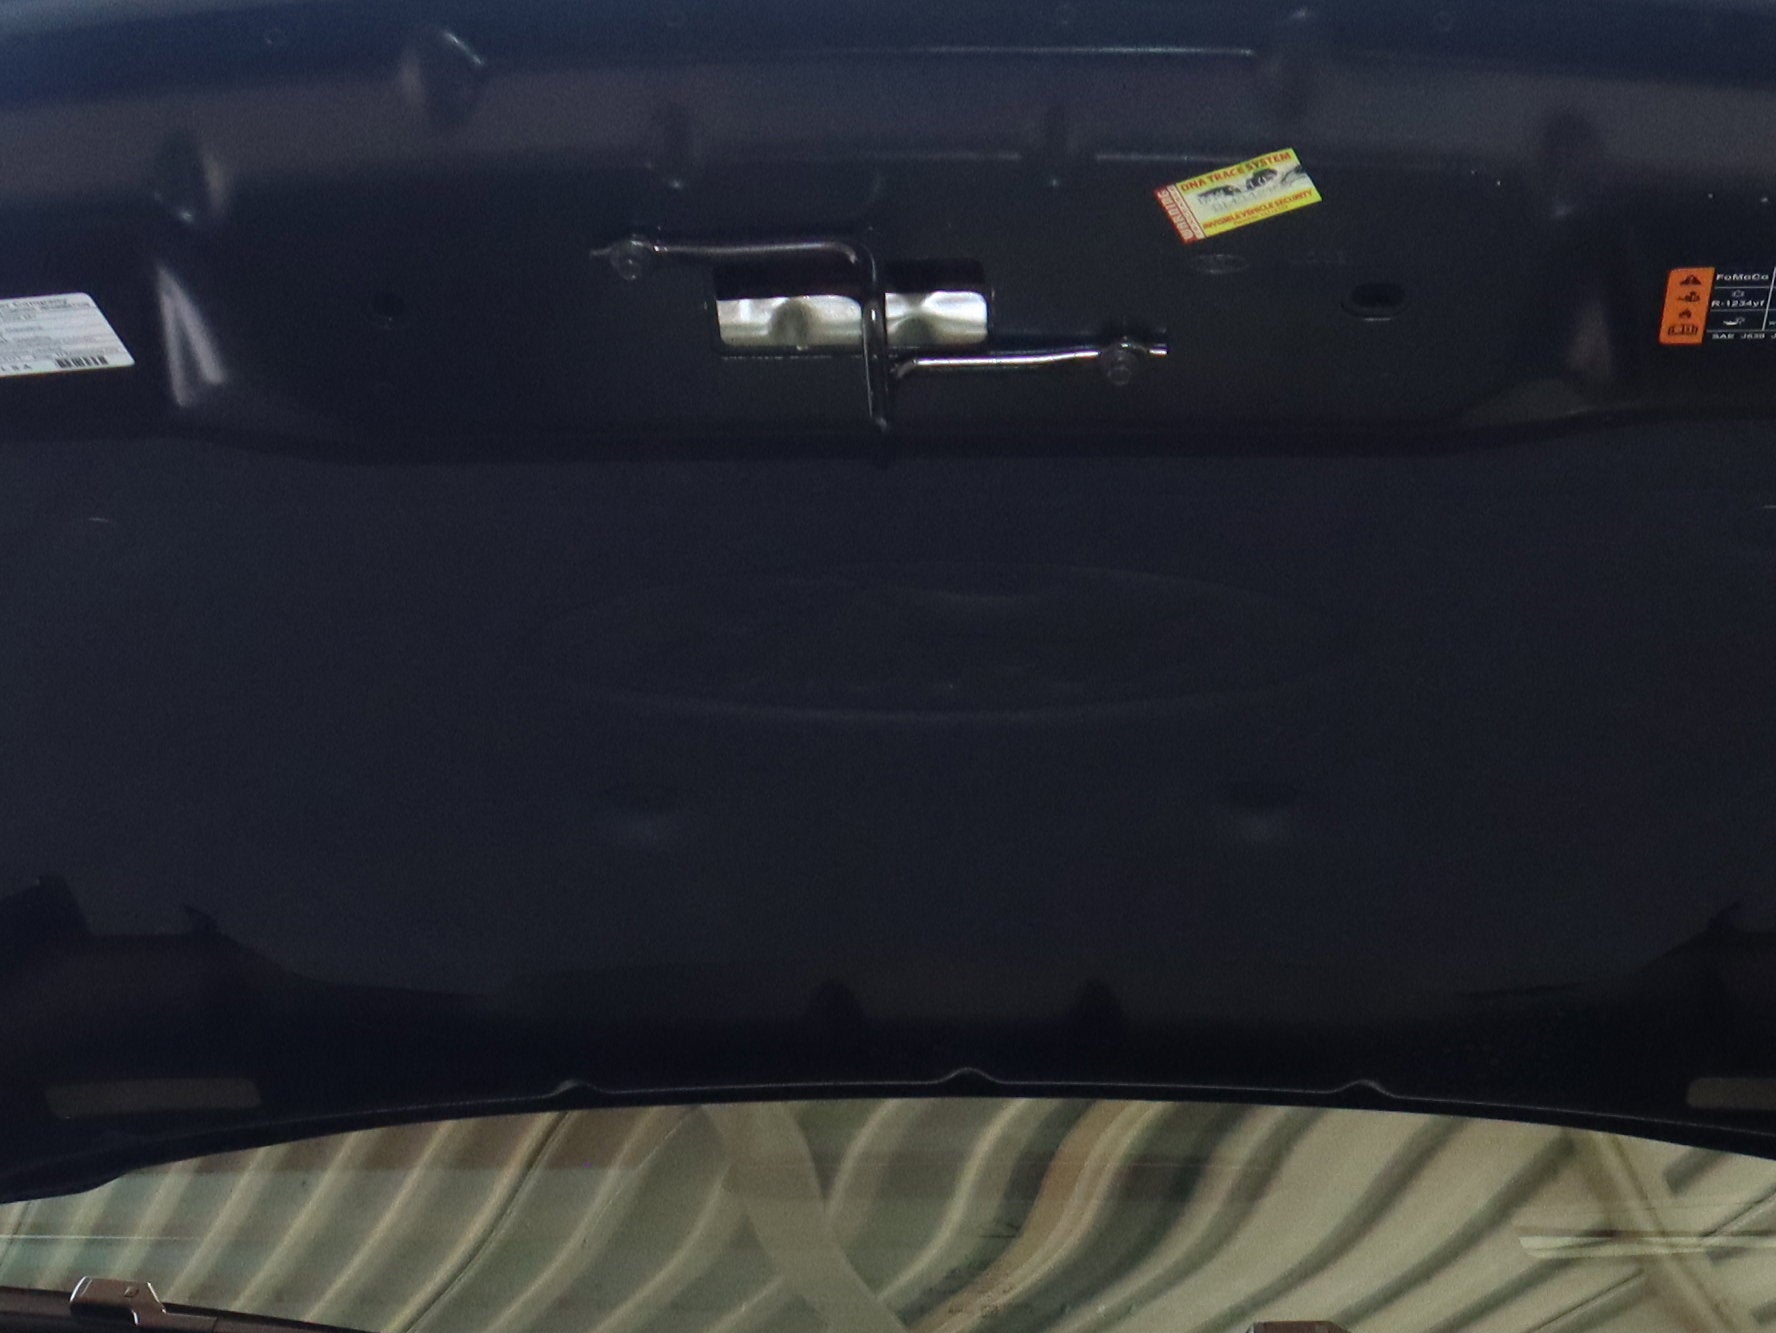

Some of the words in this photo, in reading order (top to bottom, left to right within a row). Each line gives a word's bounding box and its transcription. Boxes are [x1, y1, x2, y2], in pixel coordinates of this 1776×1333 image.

[1180, 179, 1206, 192] DNA
[1208, 167, 1245, 185] TRACE
[1246, 152, 1292, 171] SYSTEM
[1242, 202, 1275, 220] VEHICLE
[1275, 190, 1313, 208] SECURITY
[1716, 273, 1770, 281] FoMoCo
[1711, 300, 1765, 309] R-1234yf
